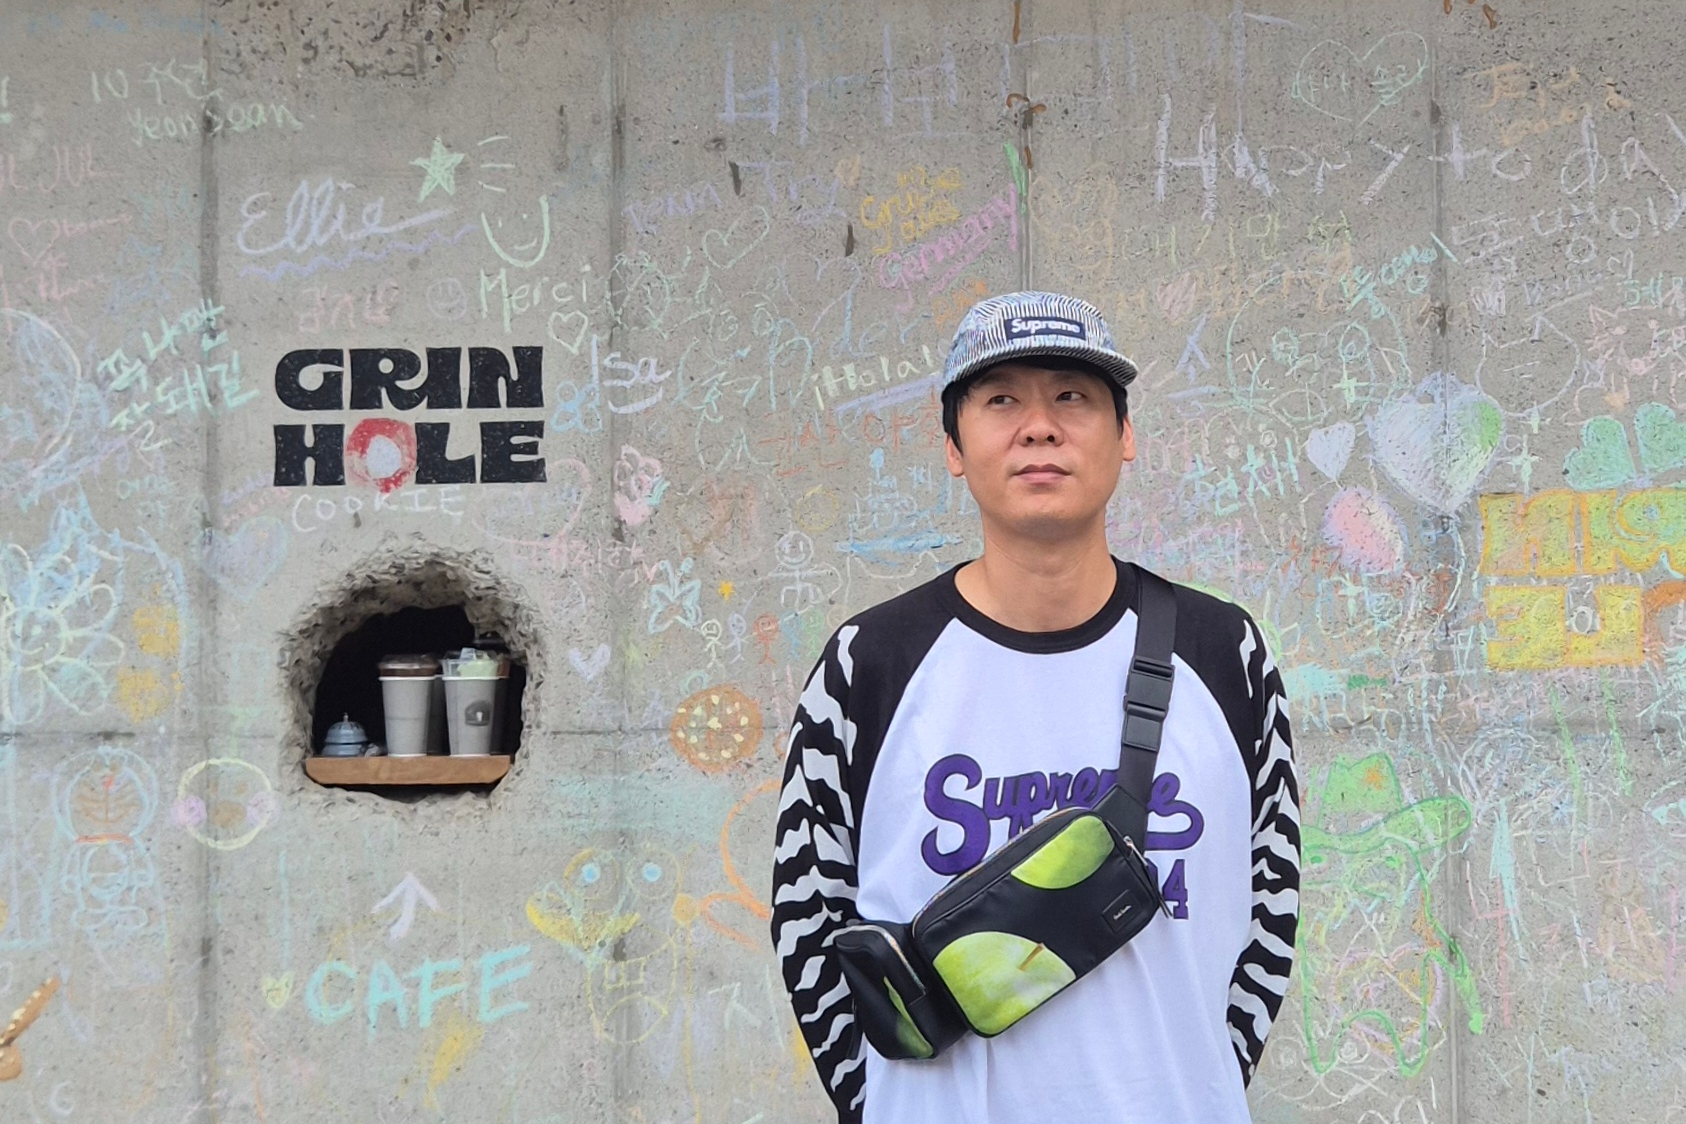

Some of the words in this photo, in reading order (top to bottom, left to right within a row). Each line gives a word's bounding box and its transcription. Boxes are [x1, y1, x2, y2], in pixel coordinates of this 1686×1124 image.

[236, 176, 455, 255] Ellie
[480, 264, 594, 334] Merci
[1011, 318, 1081, 334] Supreme
[275, 345, 544, 411] GRIN
[273, 417, 547, 493] HOLE
[292, 485, 466, 533] COOKIE
[304, 944, 533, 1042] CAFE
